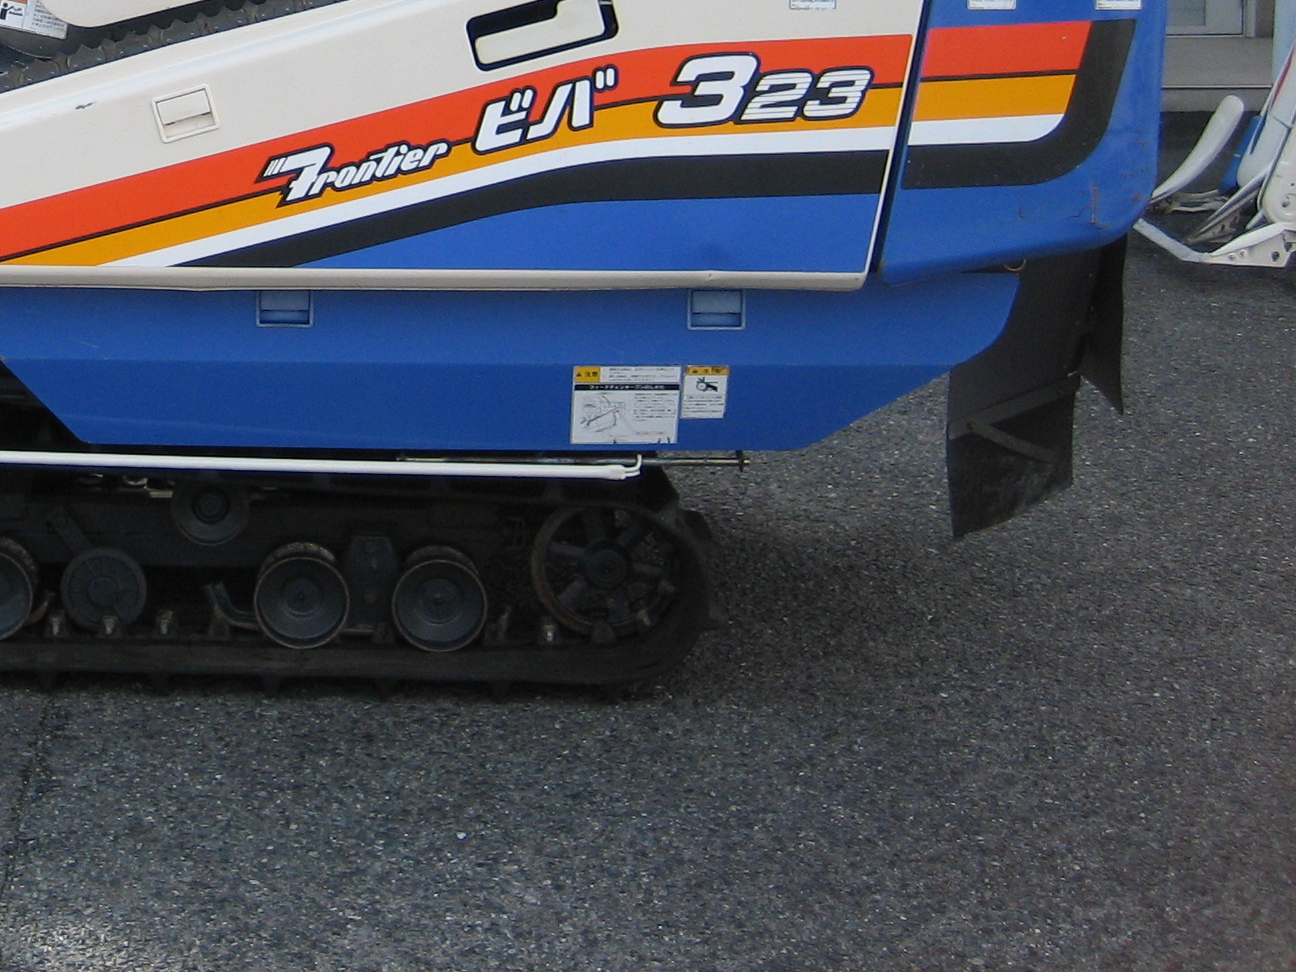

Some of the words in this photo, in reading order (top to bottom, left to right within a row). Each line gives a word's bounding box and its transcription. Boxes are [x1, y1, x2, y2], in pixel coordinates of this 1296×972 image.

[262, 142, 450, 202] Frontier
[471, 68, 616, 152] ビバ
[655, 52, 875, 128] 323
